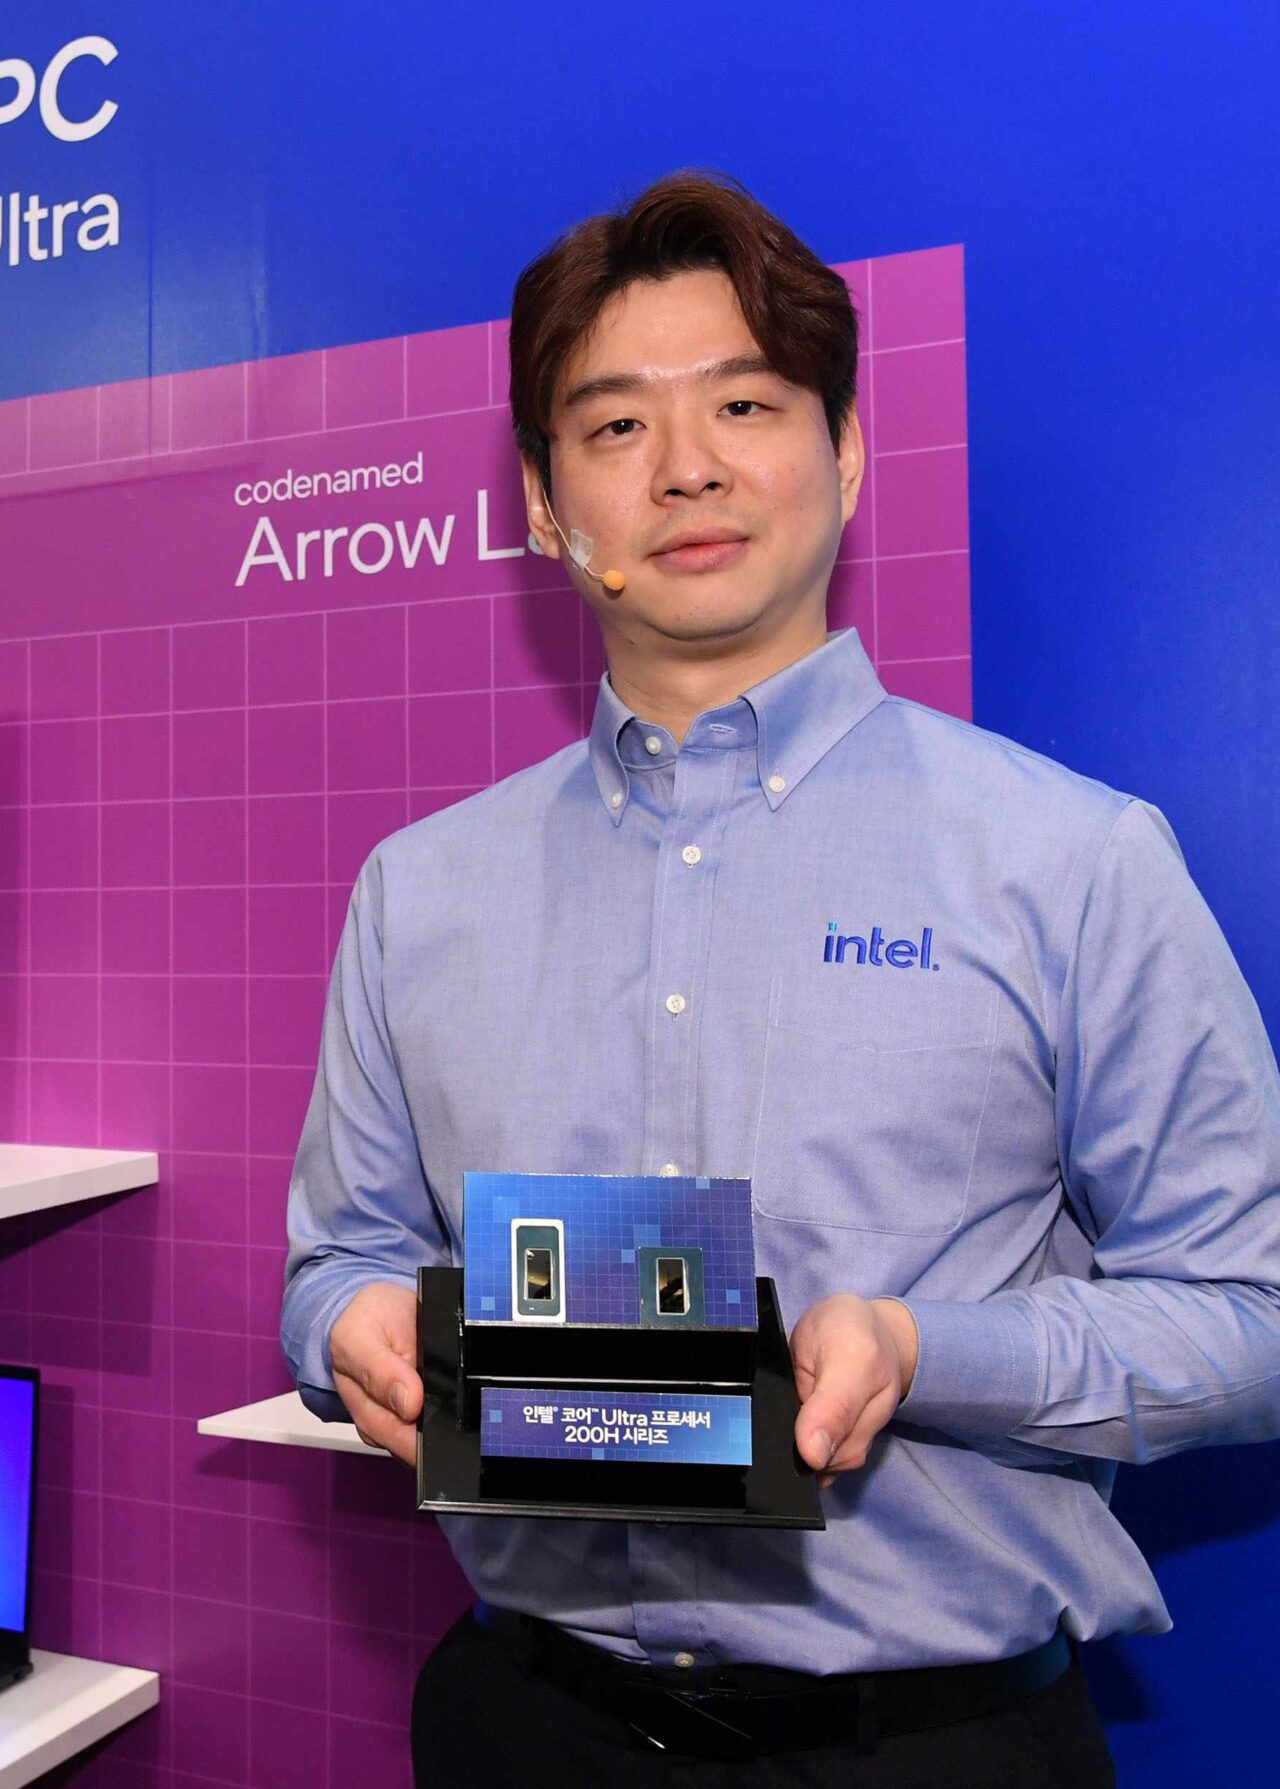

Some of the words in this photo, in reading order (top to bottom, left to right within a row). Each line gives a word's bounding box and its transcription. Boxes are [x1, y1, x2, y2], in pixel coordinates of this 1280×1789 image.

[234, 451, 424, 506] codenamed
[234, 514, 456, 588] Arrow
[476, 489, 547, 562] L
[565, 1426, 619, 1443] 200H
[623, 1428, 669, 1445] 시리즈
[602, 1409, 647, 1426] Ultra
[651, 1410, 710, 1428] 프로세서
